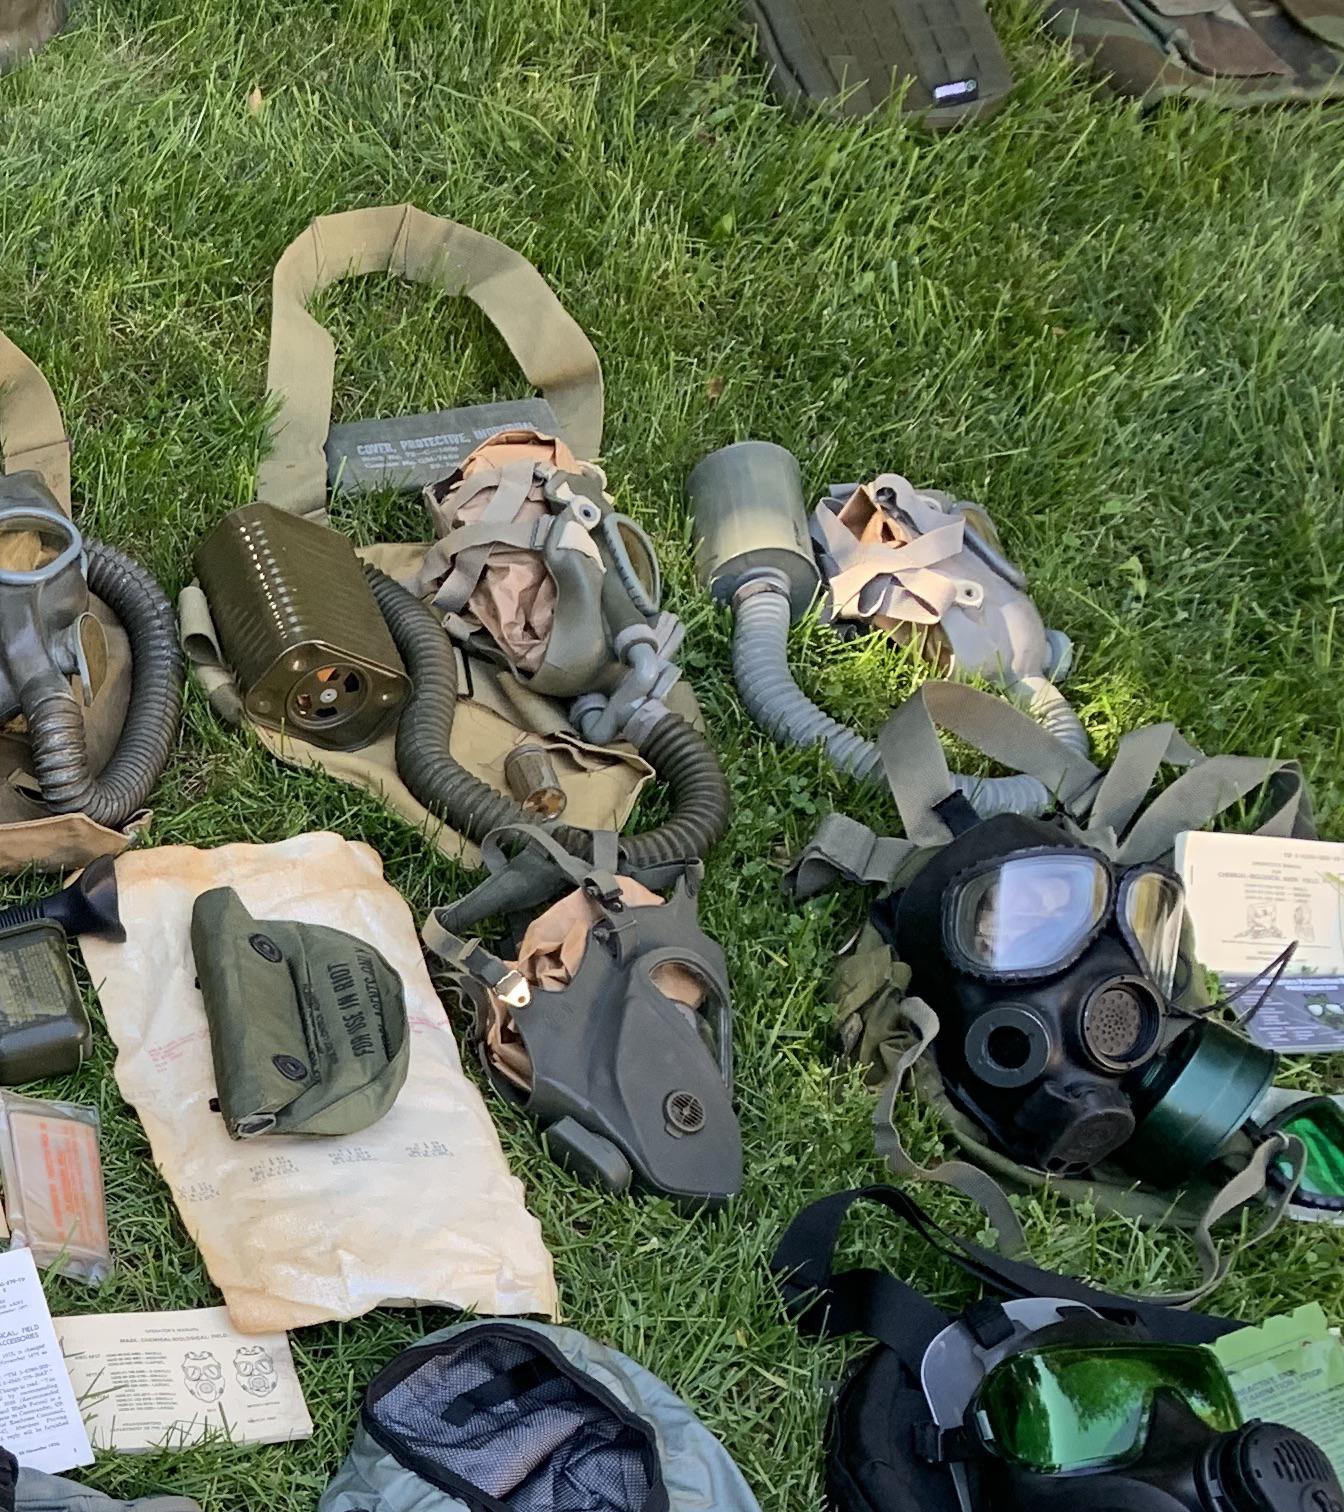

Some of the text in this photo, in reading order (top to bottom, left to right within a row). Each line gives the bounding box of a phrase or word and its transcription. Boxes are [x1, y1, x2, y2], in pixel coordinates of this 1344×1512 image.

[327, 963, 375, 1057] FOR USE IN RIOT
